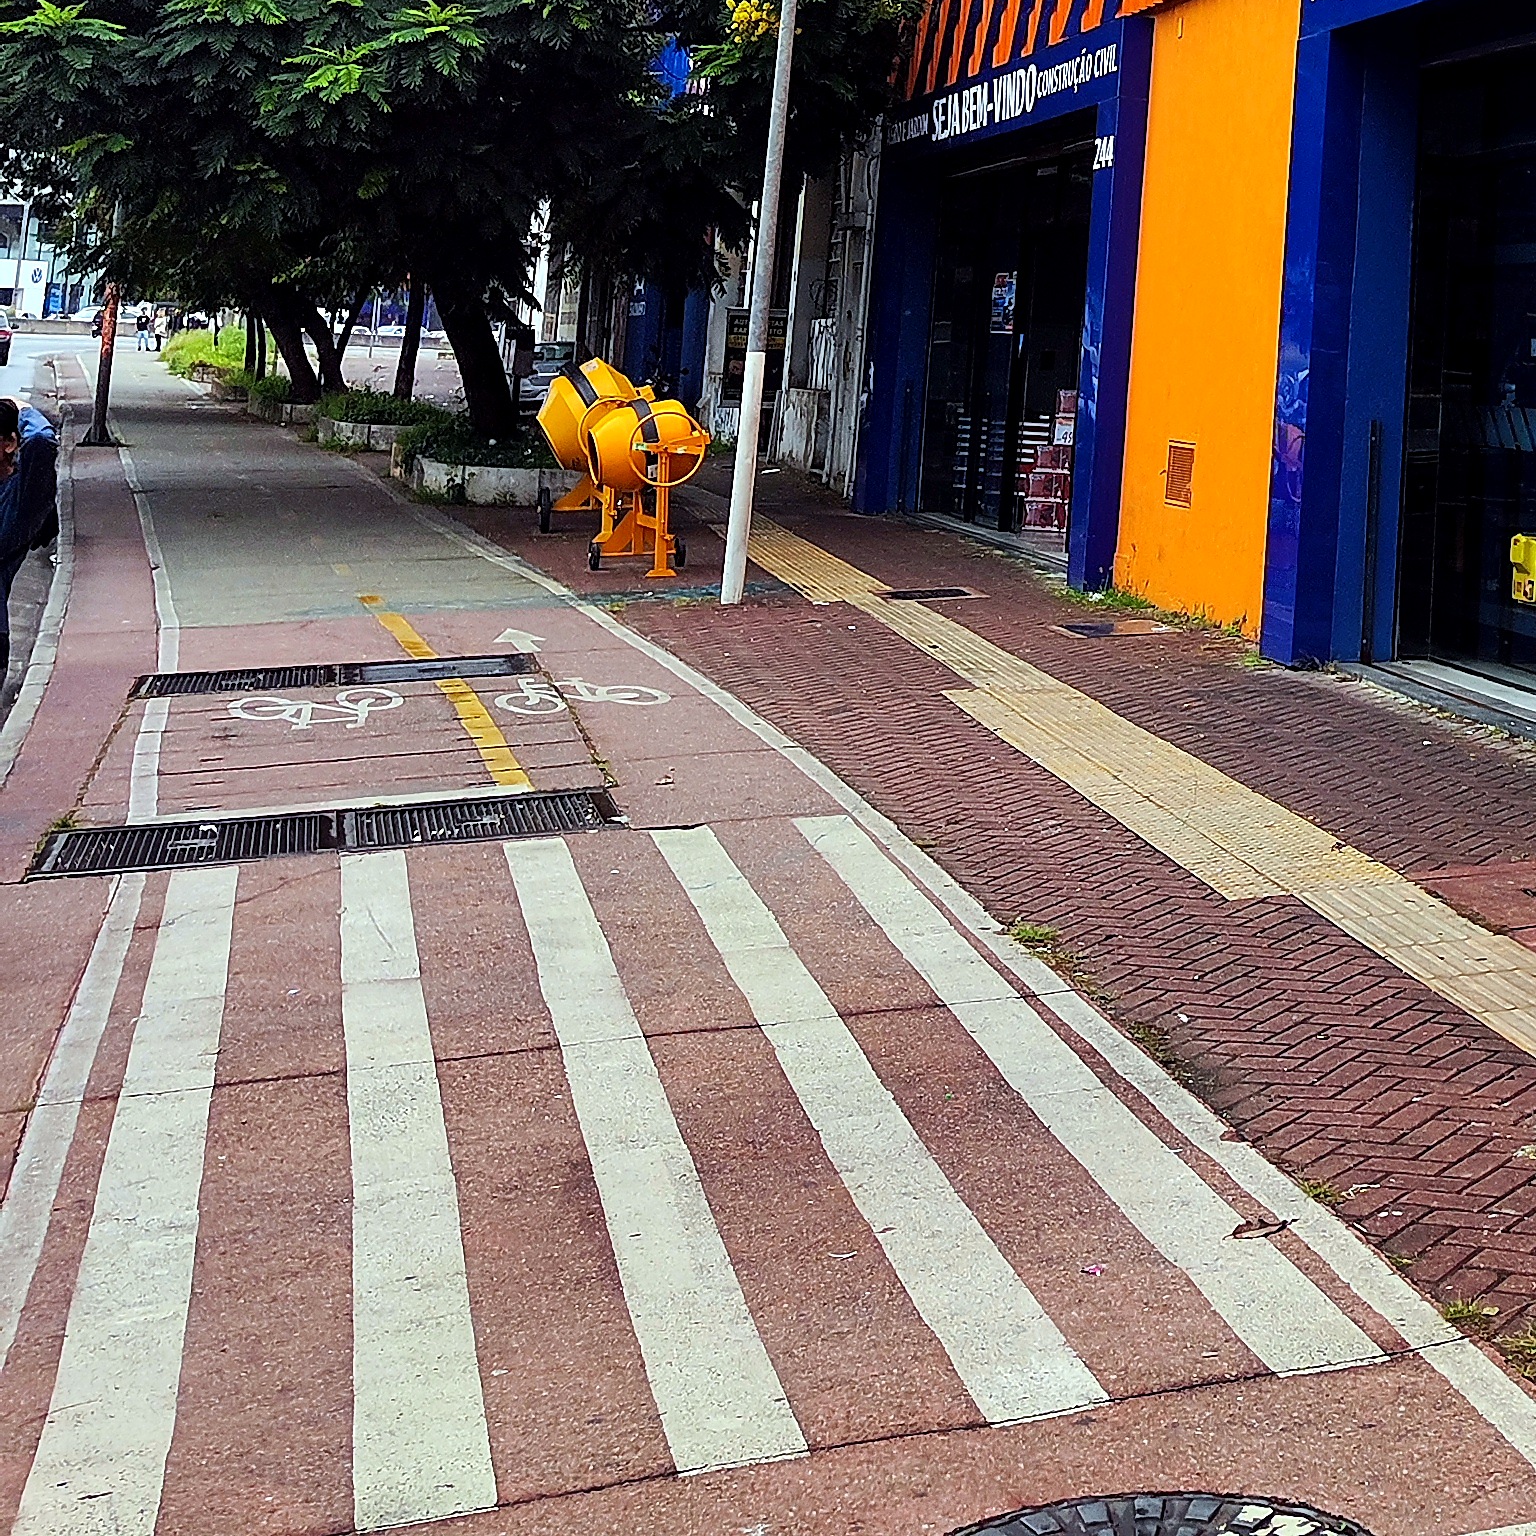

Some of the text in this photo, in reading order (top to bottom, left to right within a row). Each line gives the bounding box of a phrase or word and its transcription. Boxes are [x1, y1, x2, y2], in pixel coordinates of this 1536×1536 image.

[1037, 43, 1118, 99] CONSTRUÇÃO CIVIL
[932, 93, 961, 142] SEJA
[962, 64, 1038, 134] BEM-VINDO
[1092, 135, 1115, 171] 244
